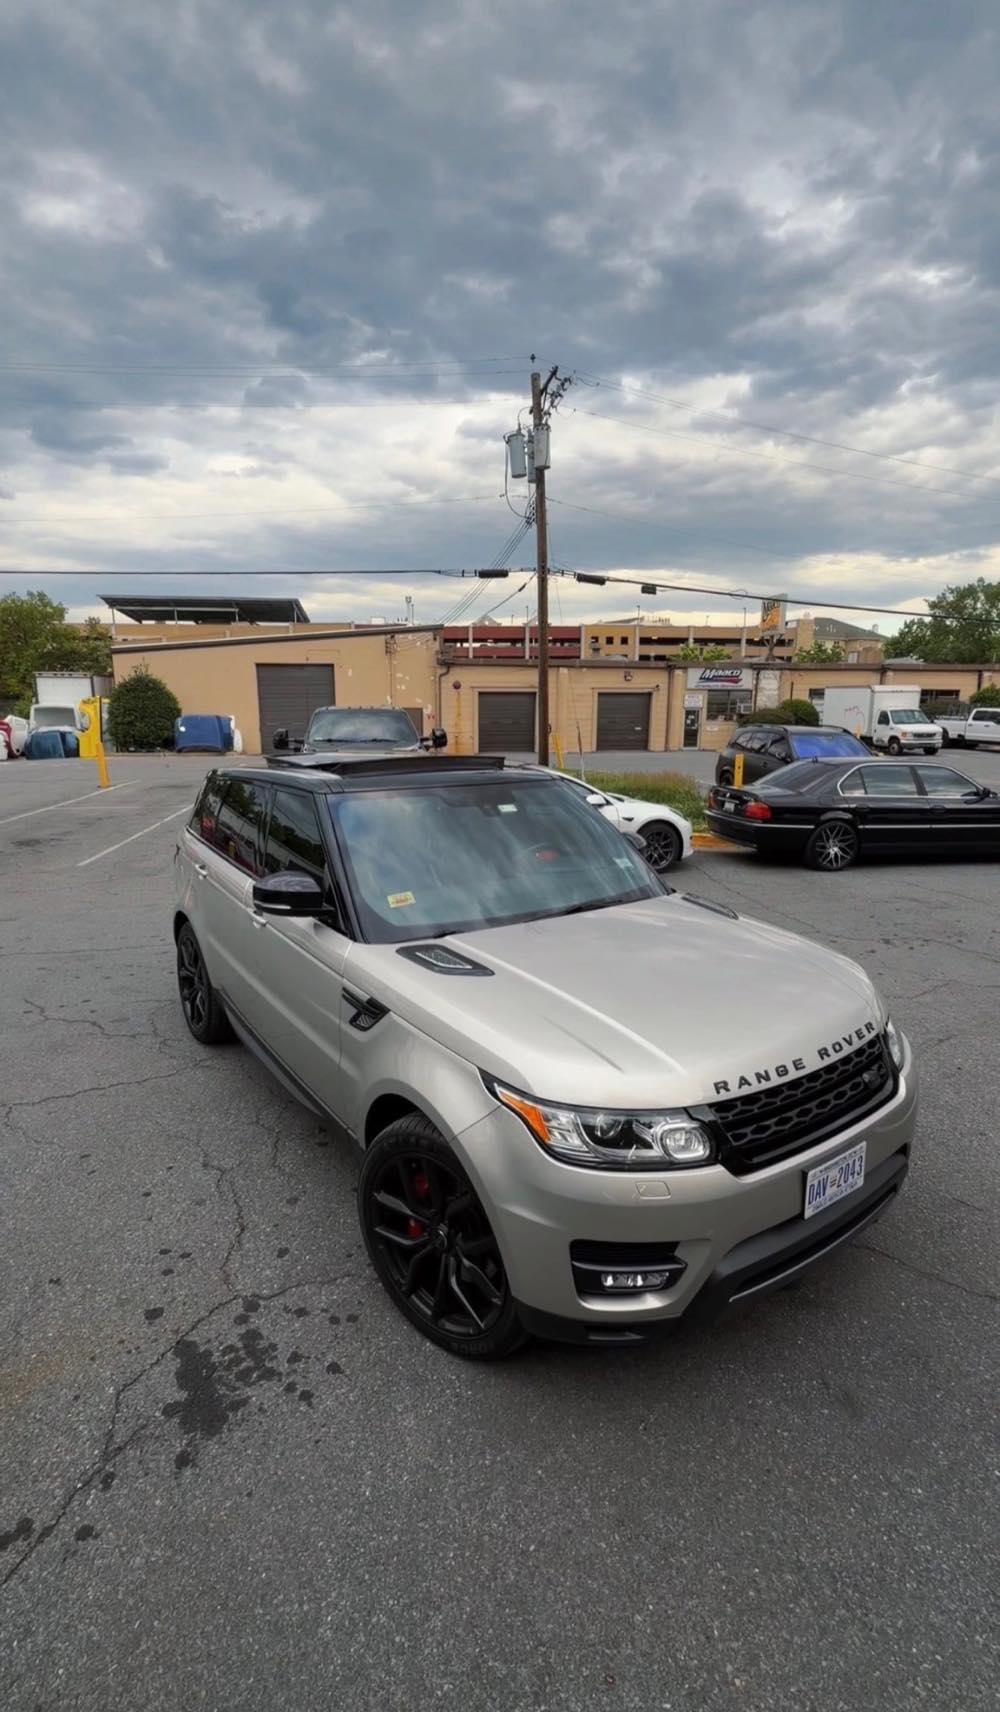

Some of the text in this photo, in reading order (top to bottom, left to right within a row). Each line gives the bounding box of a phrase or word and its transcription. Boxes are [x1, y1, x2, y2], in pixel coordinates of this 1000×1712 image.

[700, 668, 742, 680] Maaco
[713, 1021, 875, 1095] RANGE ROVER
[836, 1155, 863, 1188] 2043
